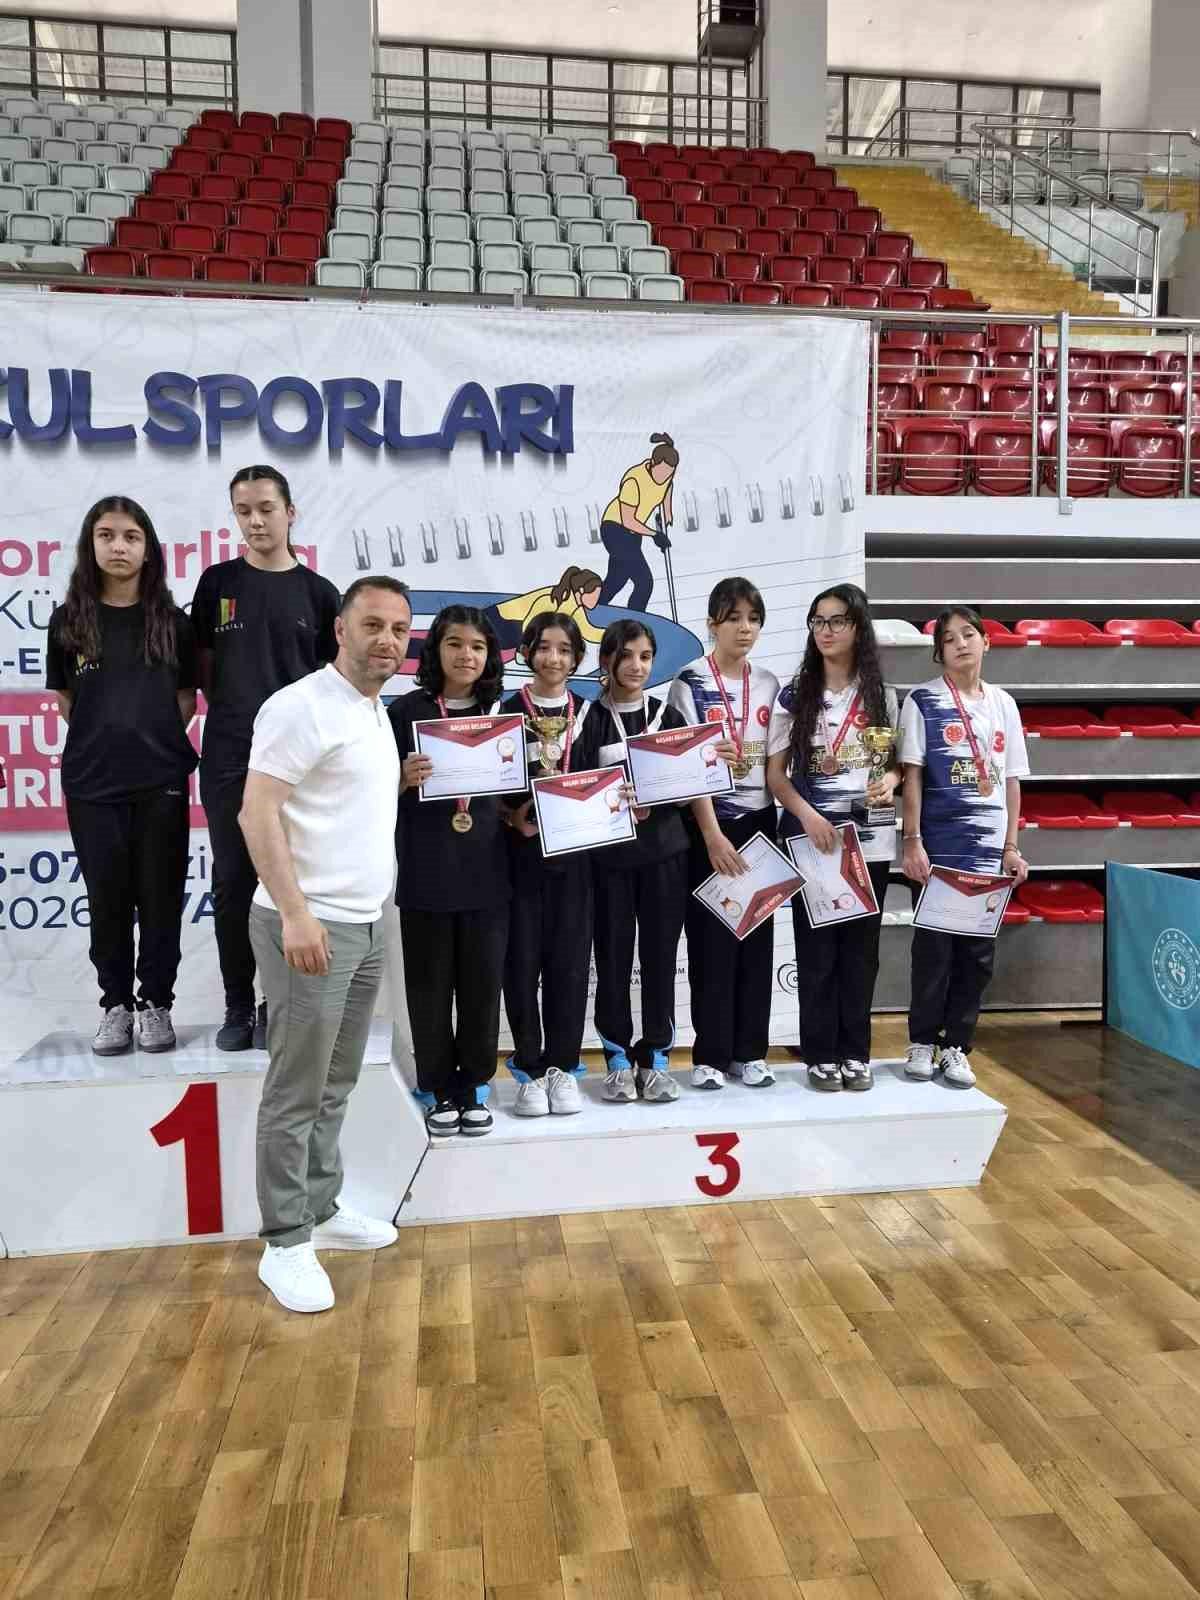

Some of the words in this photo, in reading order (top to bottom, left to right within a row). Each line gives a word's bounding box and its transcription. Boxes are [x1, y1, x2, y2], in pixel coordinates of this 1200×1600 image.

[0, 366, 137, 442] UL
[142, 371, 575, 454] SPORLARI
[0, 851, 82, 884] -07
[0, 895, 91, 930] 026
[149, 1082, 224, 1236] 1
[695, 1132, 741, 1197] 3
